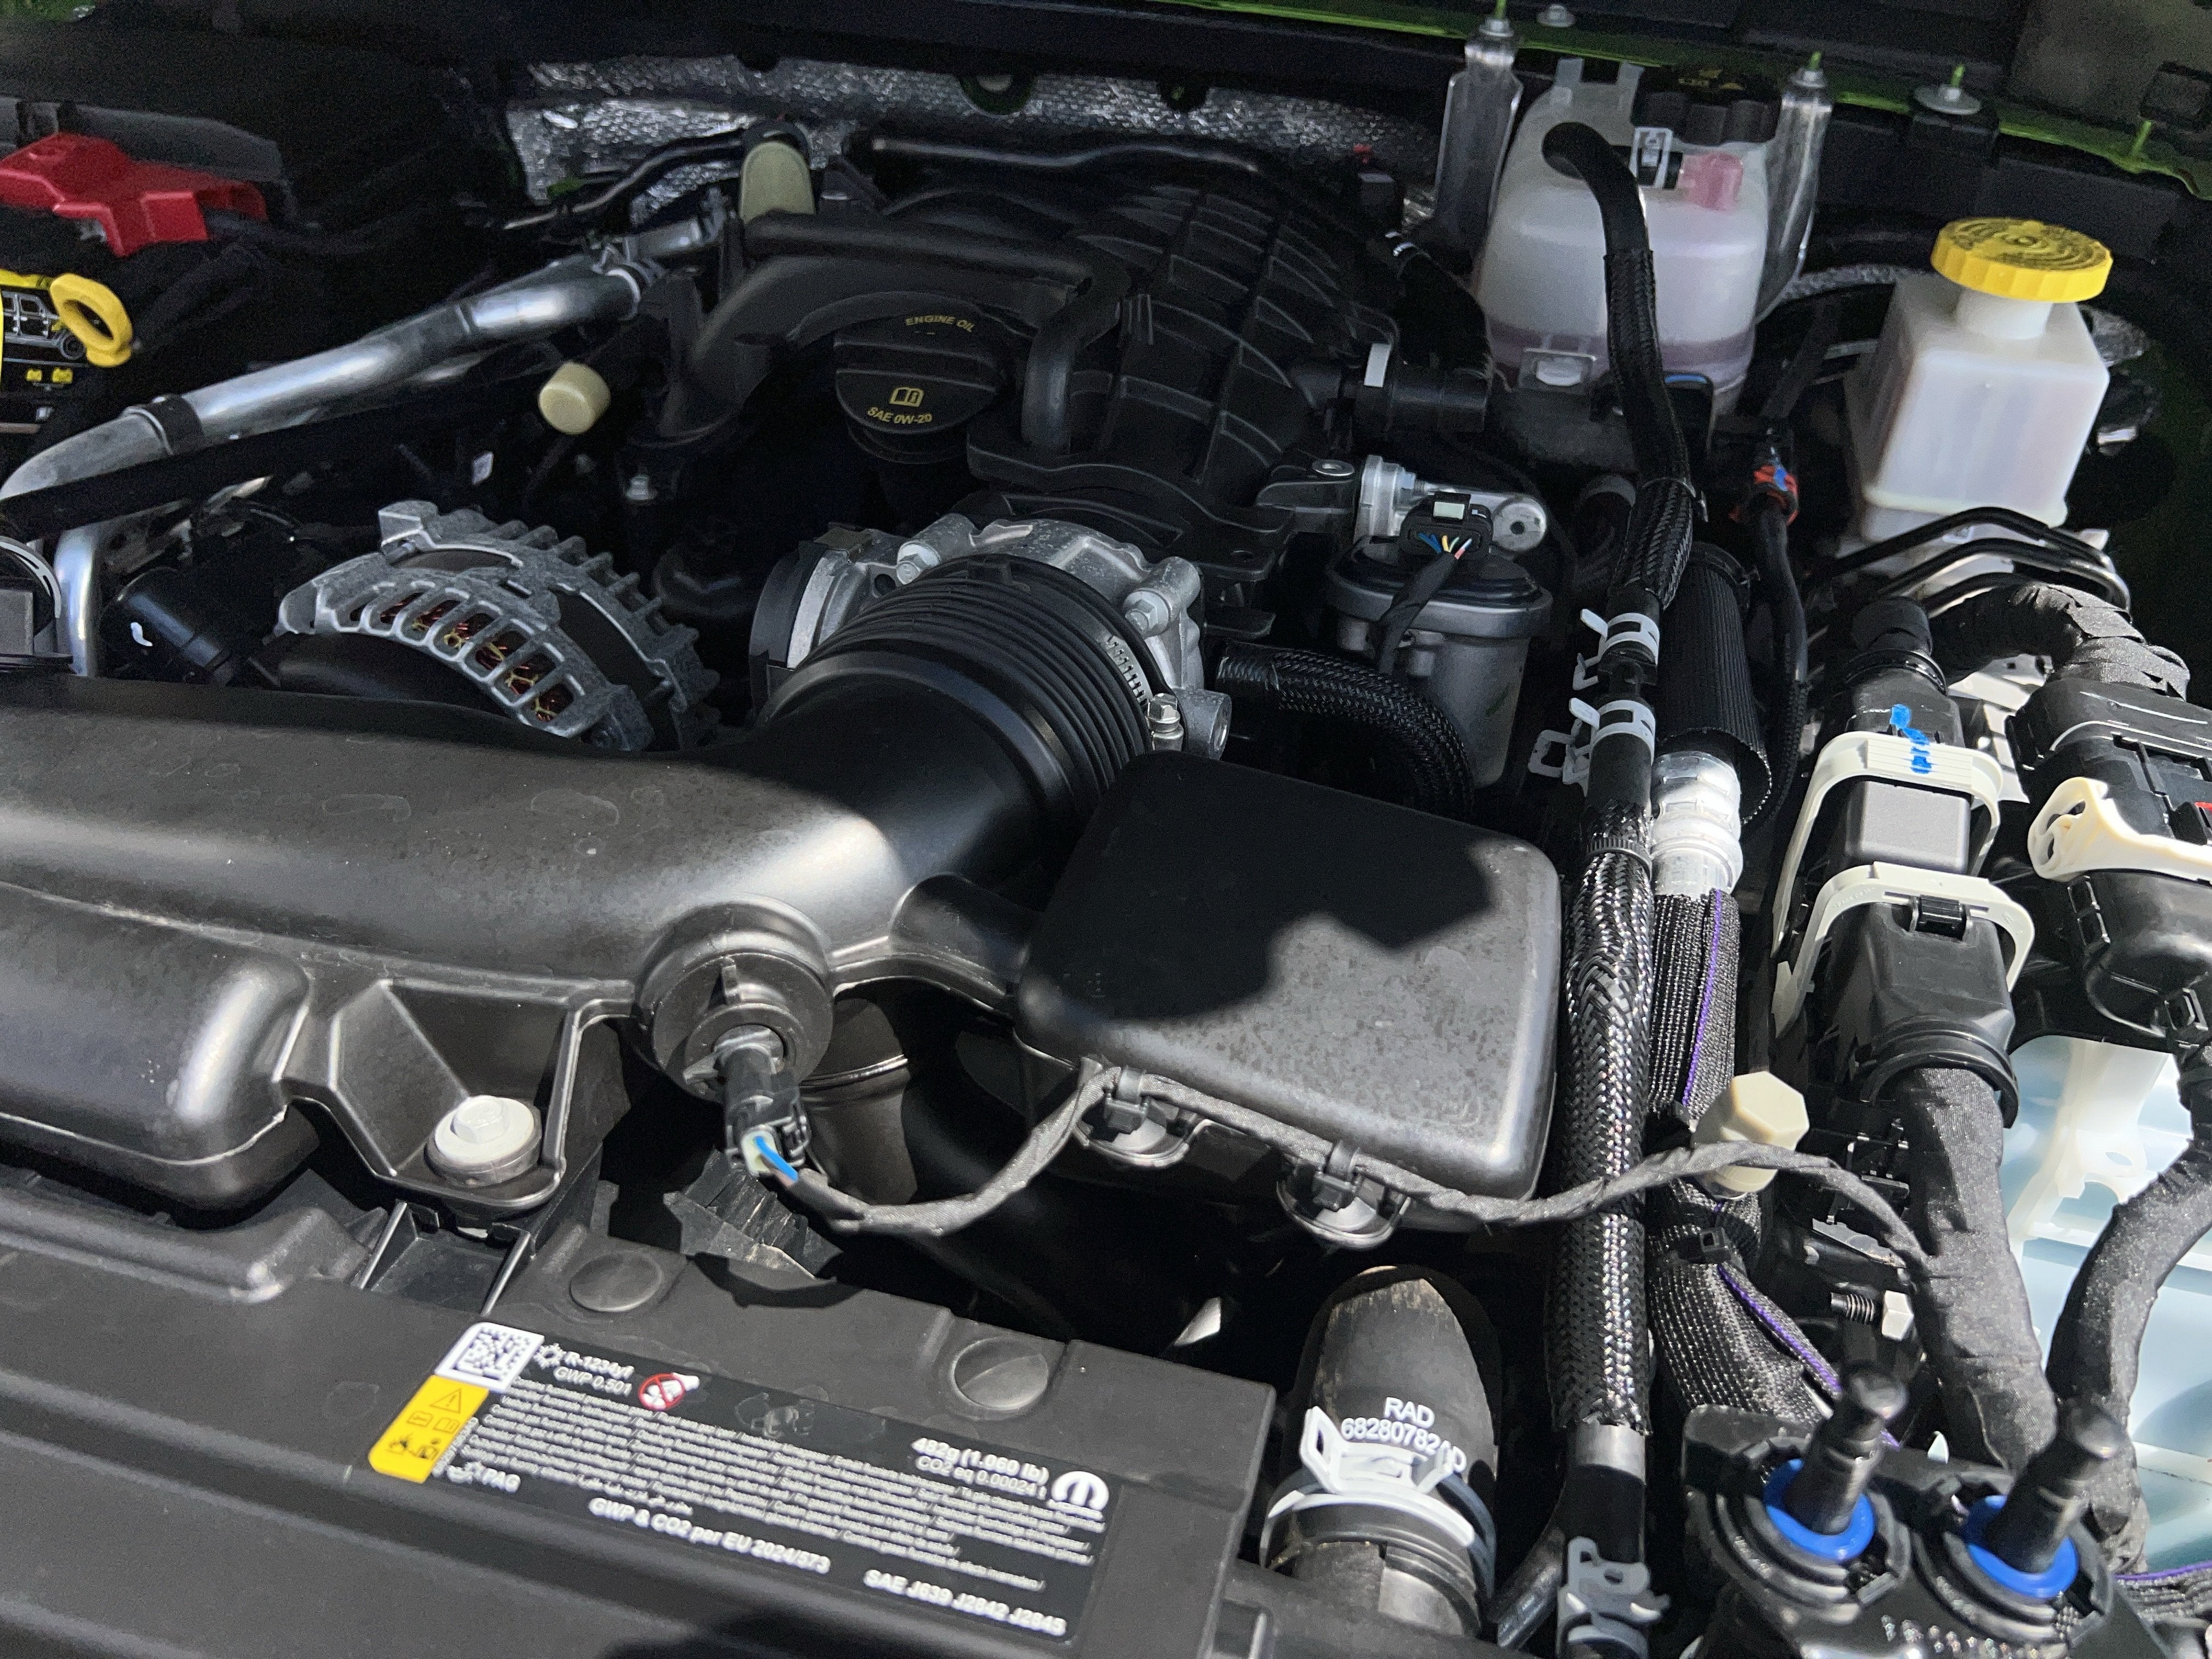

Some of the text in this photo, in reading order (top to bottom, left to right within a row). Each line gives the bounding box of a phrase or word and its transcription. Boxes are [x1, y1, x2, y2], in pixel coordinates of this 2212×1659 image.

[905, 315, 975, 332] ENGINE OIL
[867, 407, 932, 425] SAE 0W-20
[554, 1366, 633, 1397] GWP 0.501
[1384, 1396, 1435, 1429] RAD
[911, 1437, 1050, 1487] 482g (1.060 lb)
[916, 1455, 950, 1476] CO2
[975, 1468, 1036, 1497] 0.00024
[482, 1467, 521, 1493] PAG
[590, 1498, 831, 1575] GWP & CO2 per EU 2024/573
[864, 1570, 905, 1596] SAE
[905, 1581, 953, 1608] J639
